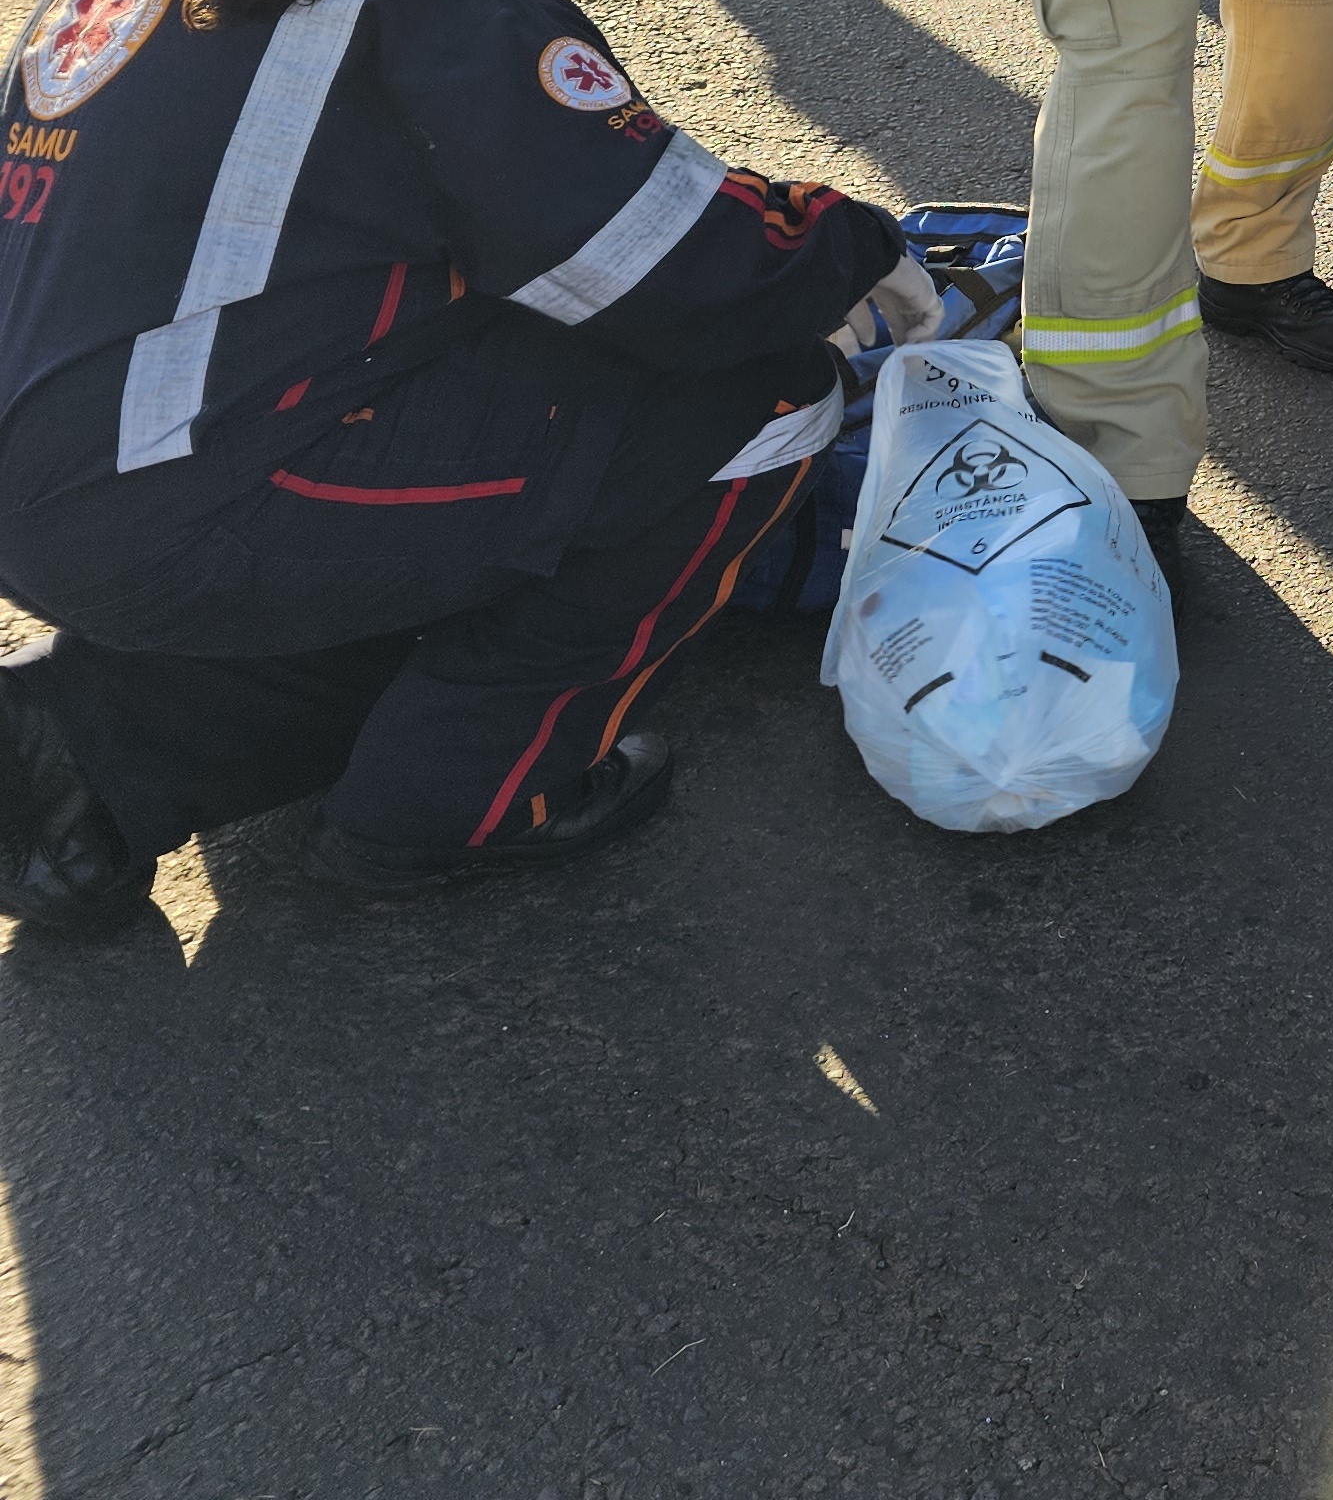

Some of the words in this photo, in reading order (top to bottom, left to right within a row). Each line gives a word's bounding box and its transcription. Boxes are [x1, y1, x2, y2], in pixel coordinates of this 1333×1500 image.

[7, 121, 78, 162] SAMU
[624, 113, 664, 143] 19
[899, 398, 961, 418] RESÍDUO
[934, 492, 1028, 520] SUBSTÂNCIA
[937, 503, 1026, 533] INFECTANTE
[971, 537, 988, 555] 6
